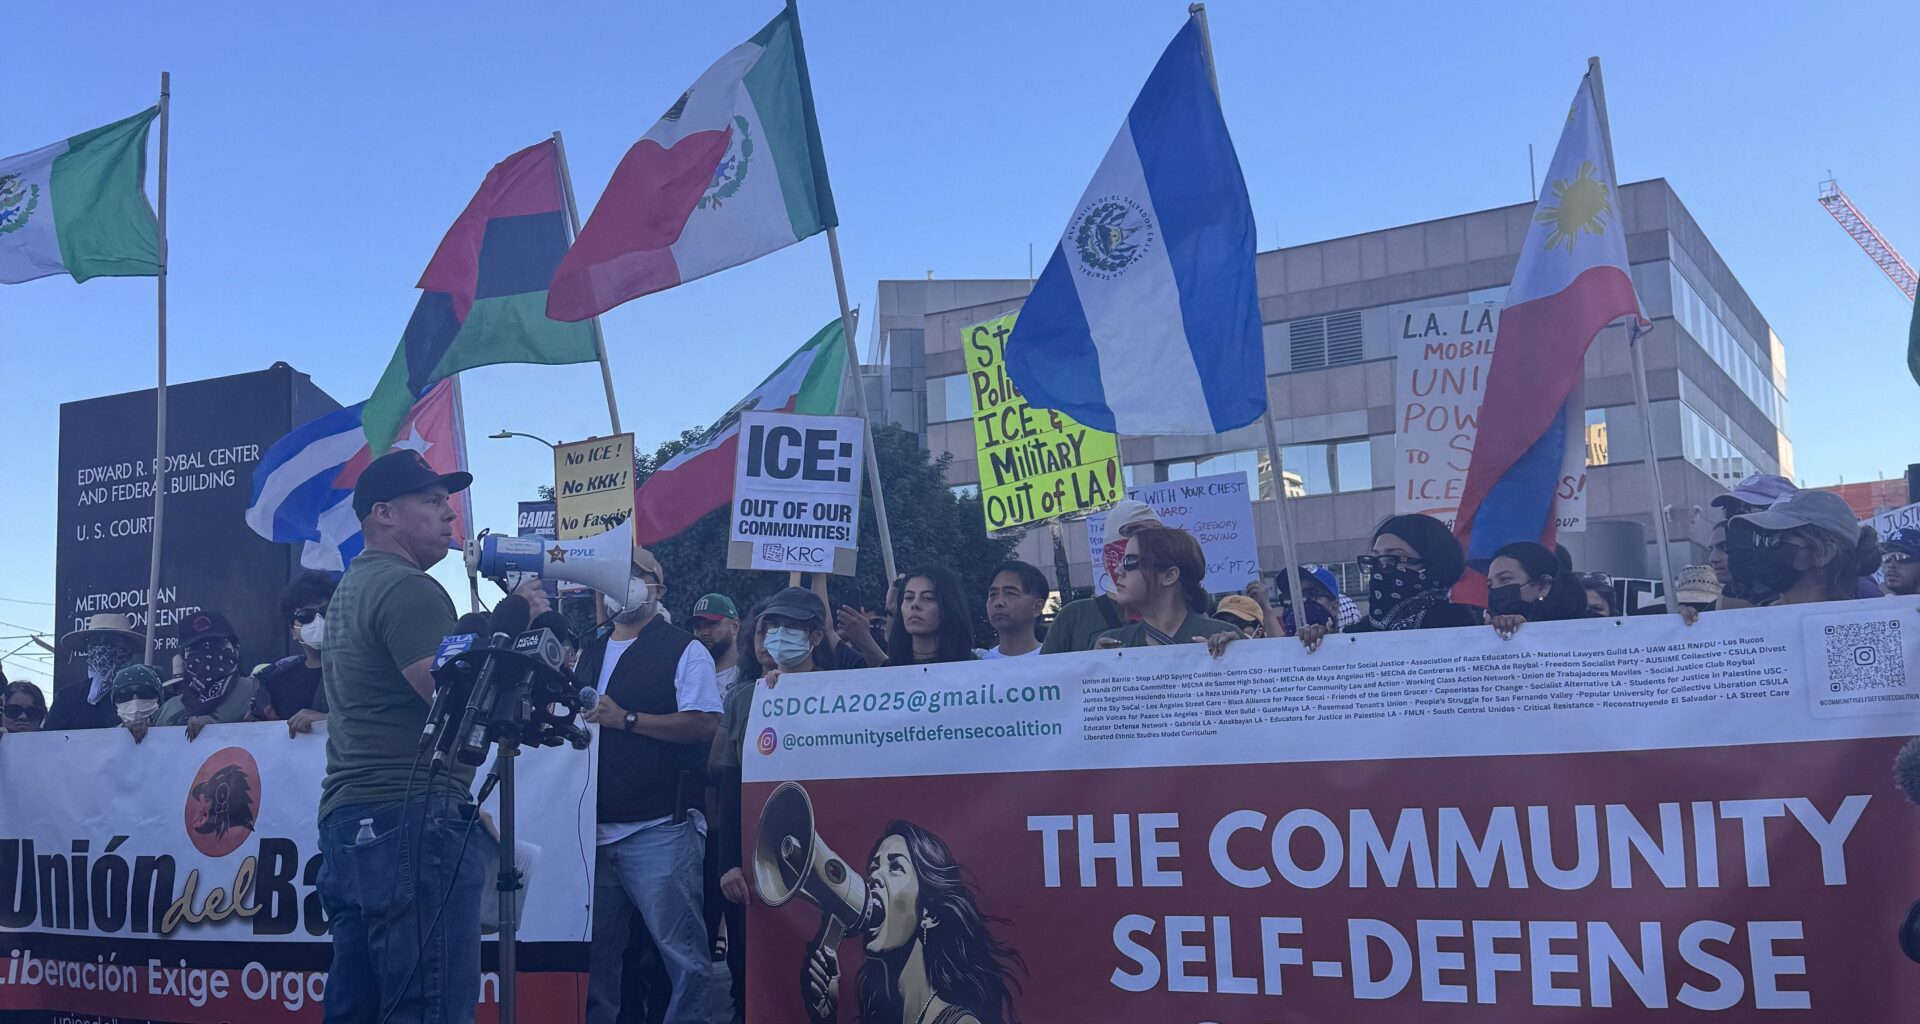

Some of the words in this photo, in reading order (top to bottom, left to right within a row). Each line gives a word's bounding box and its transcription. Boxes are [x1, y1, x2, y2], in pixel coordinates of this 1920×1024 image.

[1402, 312, 1447, 338] L.A.
[972, 365, 1023, 411] Polic
[564, 451, 584, 466] No
[746, 424, 853, 482] ICE:
[78, 460, 132, 486] EDWARD
[136, 460, 148, 478] R.
[208, 444, 260, 466] CENTER
[78, 488, 108, 506] AND
[172, 470, 236, 494] BUILDING
[562, 480, 584, 496] No
[1144, 488, 1176, 504] WITH
[1208, 482, 1247, 496] CHEST
[519, 511, 556, 528] GAME
[740, 498, 778, 518] OUT
[782, 501, 808, 520] OF
[812, 502, 852, 523] OUR
[77, 525, 90, 542] U.
[94, 522, 105, 539] S.
[560, 517, 578, 530] No
[738, 520, 850, 541] COMMUNITIES!
[1194, 520, 1238, 532] GREGORY
[1200, 532, 1238, 544] BOVINO
[570, 548, 595, 556] PYLE
[786, 546, 824, 562] KRC
[75, 586, 176, 612] METROPOLIAN
[518, 634, 539, 643] KCAL
[762, 682, 1062, 718] CSDCLA2025@gmail.com
[1602, 699, 1668, 707] Reconstruyendo
[1681, 694, 1716, 702] Salvador
[782, 720, 1062, 750] @communityselfdefensecoalition
[1027, 812, 1183, 889] THE
[1208, 794, 1873, 891] COMMUNITY
[160, 855, 264, 935] del
[1110, 914, 1812, 1010] SELF-DEFENSE
[148, 959, 230, 1007] Exige
